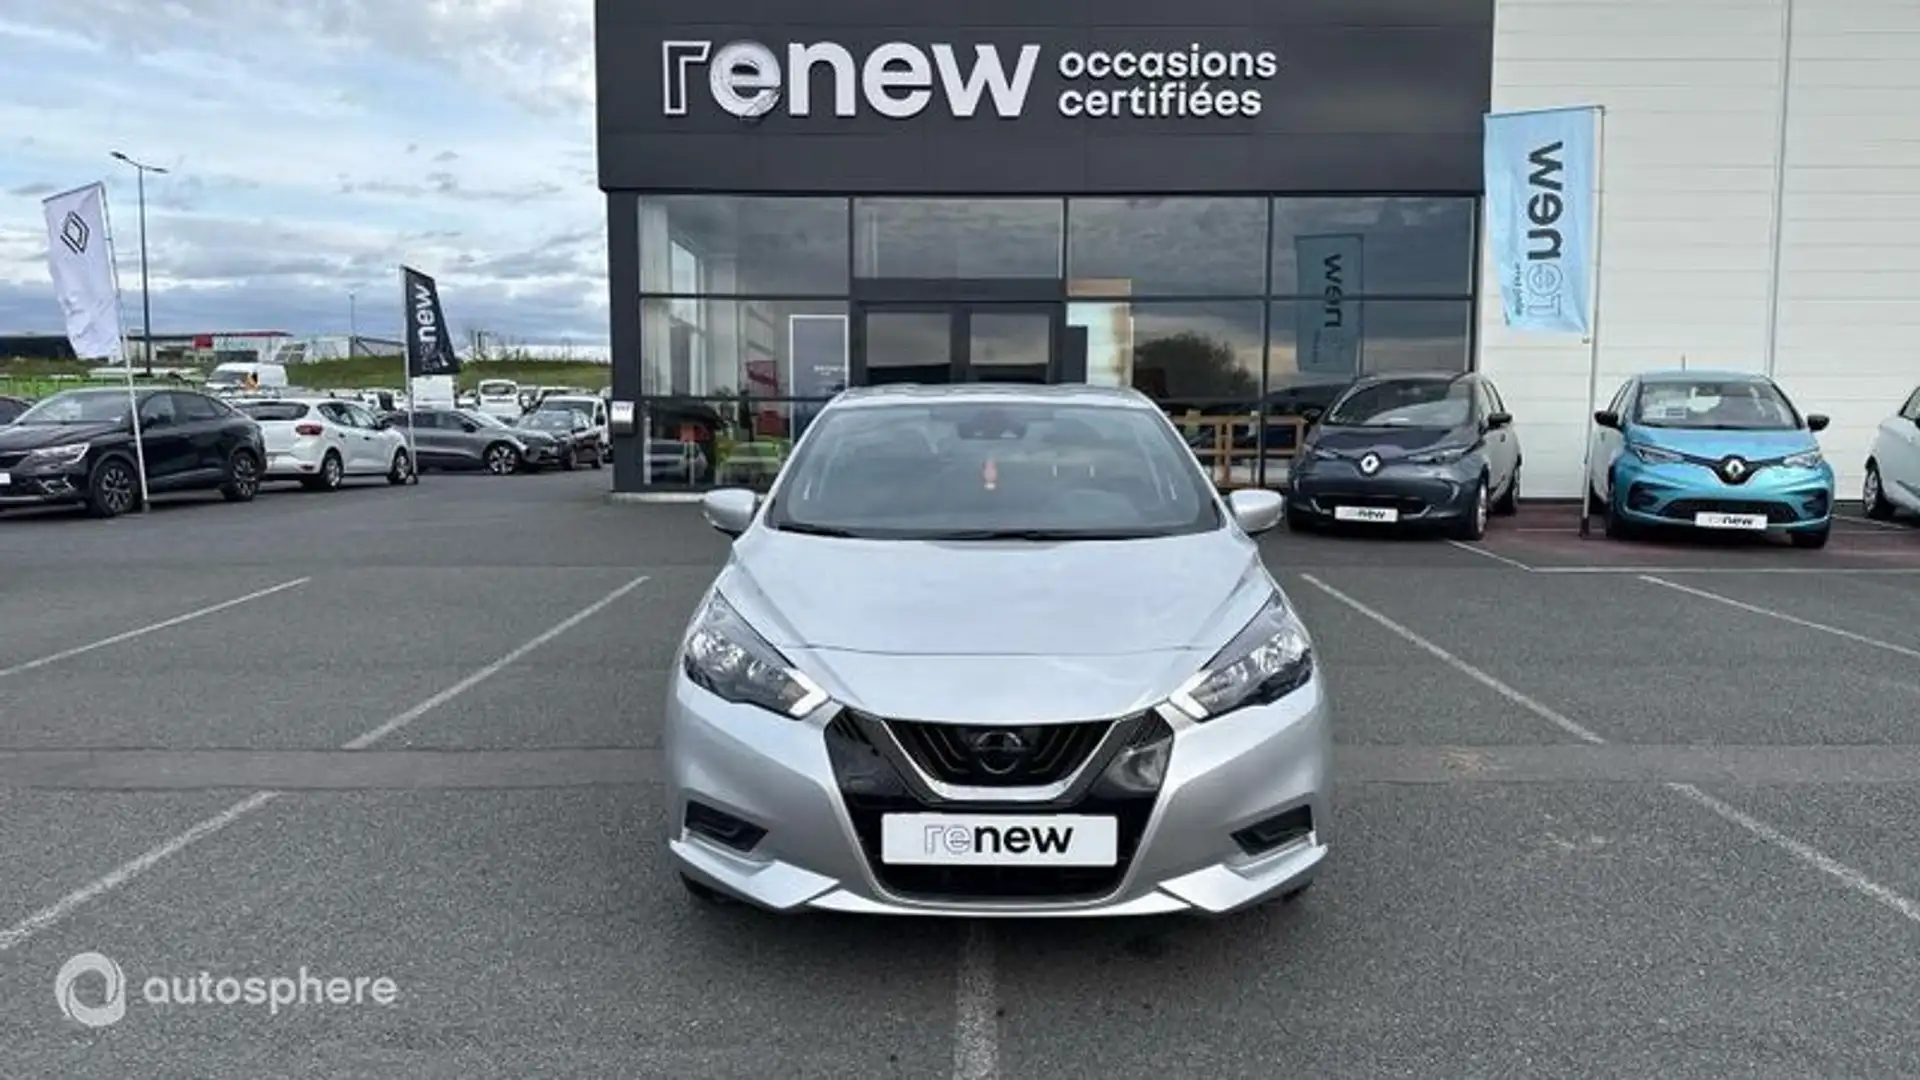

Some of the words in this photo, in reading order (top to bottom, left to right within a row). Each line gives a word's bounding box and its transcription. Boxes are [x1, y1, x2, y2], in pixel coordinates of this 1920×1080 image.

[1058, 43, 1277, 77] occasions
[662, 39, 1040, 117] renew
[1058, 82, 1262, 116] certifiées
[924, 825, 1074, 854] renew
